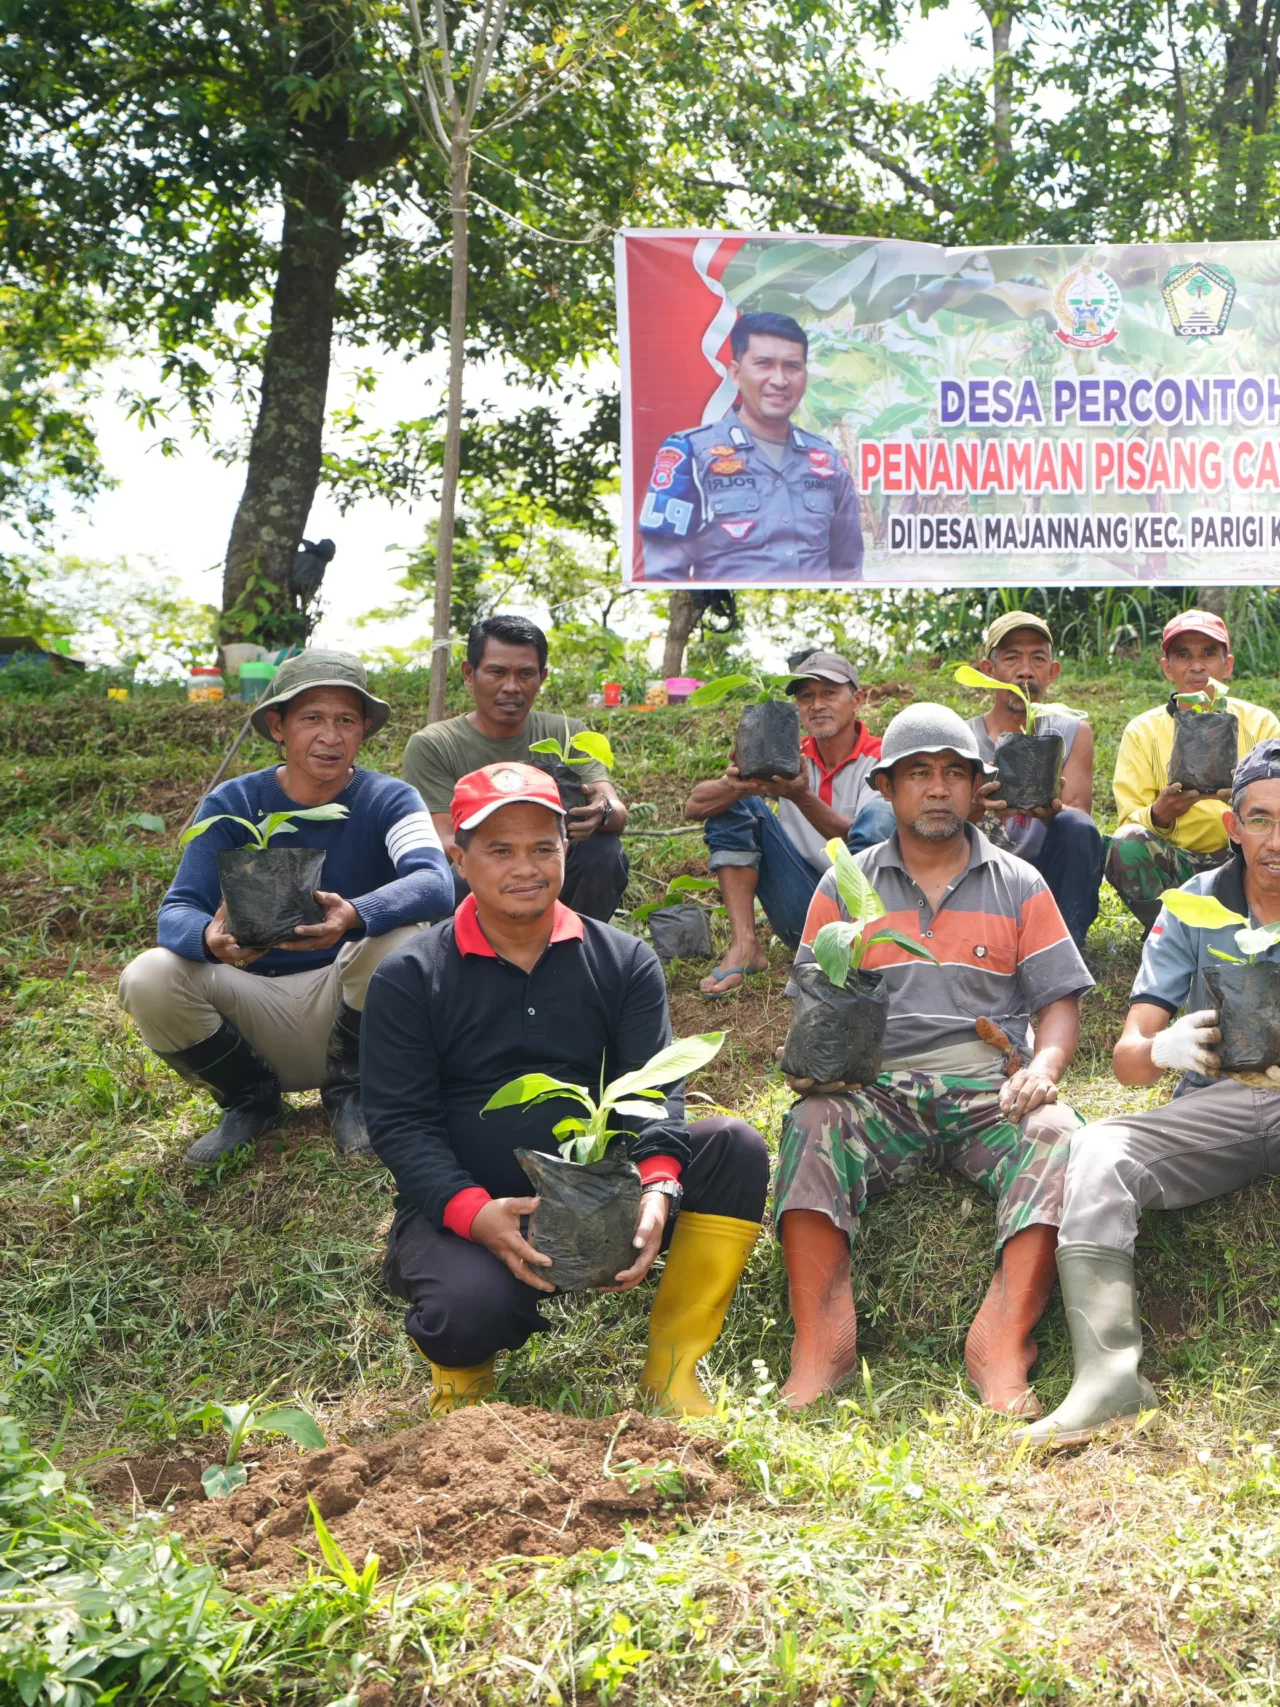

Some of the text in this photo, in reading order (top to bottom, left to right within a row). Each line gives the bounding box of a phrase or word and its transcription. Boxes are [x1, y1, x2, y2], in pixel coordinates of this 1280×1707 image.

[1179, 326, 1221, 336] GOWA
[940, 379, 1043, 423] DESA
[861, 442, 1083, 491] PENANAMAN
[1095, 440, 1222, 491] PISANG
[891, 518, 912, 550] DI
[919, 518, 978, 550] DESA
[984, 516, 1128, 550] MAJANNANG
[1134, 516, 1184, 549] KEC.
[1191, 515, 1264, 548] PARIGI
